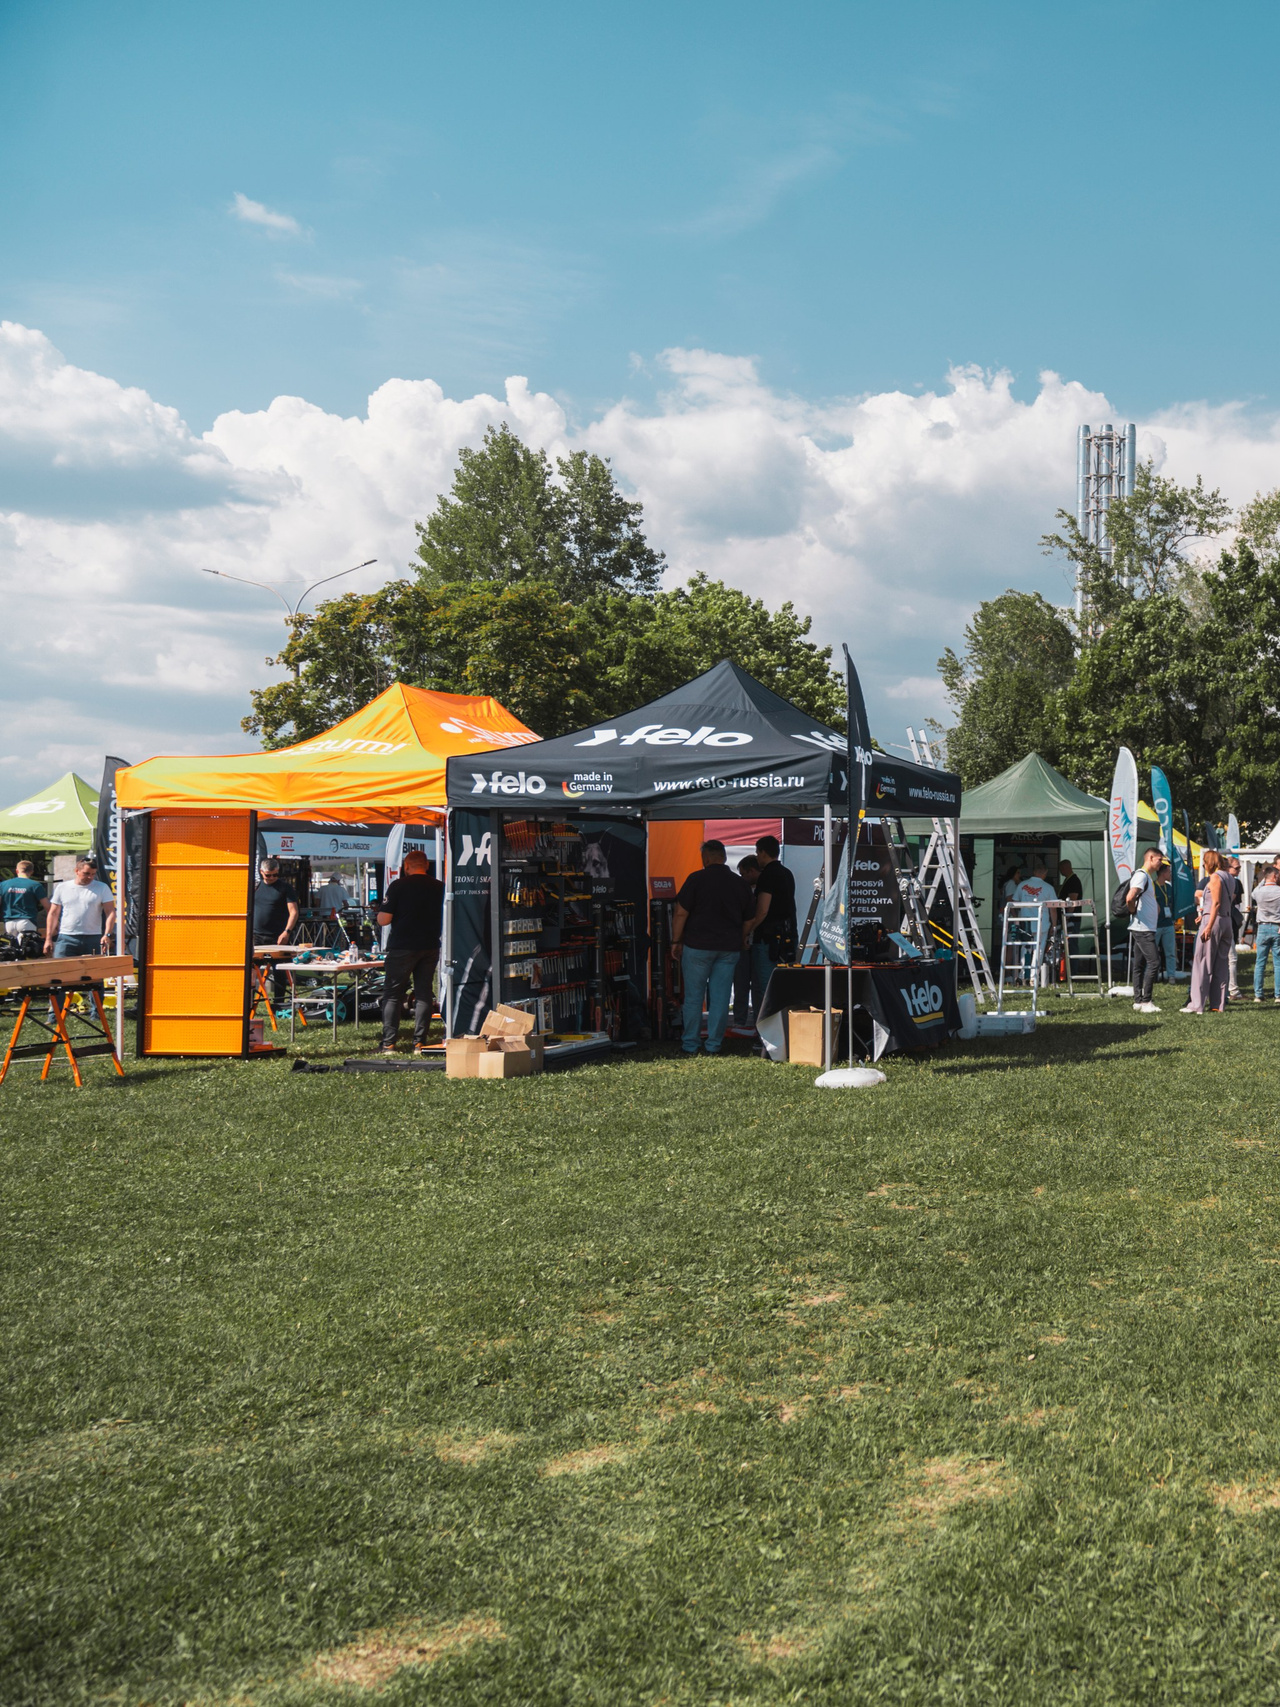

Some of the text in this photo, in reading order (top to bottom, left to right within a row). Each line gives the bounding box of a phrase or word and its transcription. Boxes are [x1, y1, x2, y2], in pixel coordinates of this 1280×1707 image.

[619, 724, 753, 747] felo
[574, 772, 613, 782] made in
[653, 773, 805, 792] www.felo-russia.ru
[488, 771, 547, 795] felo
[570, 782, 613, 793] Germany
[909, 786, 956, 804] www.felo-russia.ru
[853, 860, 880, 871] felo
[851, 879, 884, 888] ПРОБУЙ
[851, 897, 893, 905] УЛЬТАНТА
